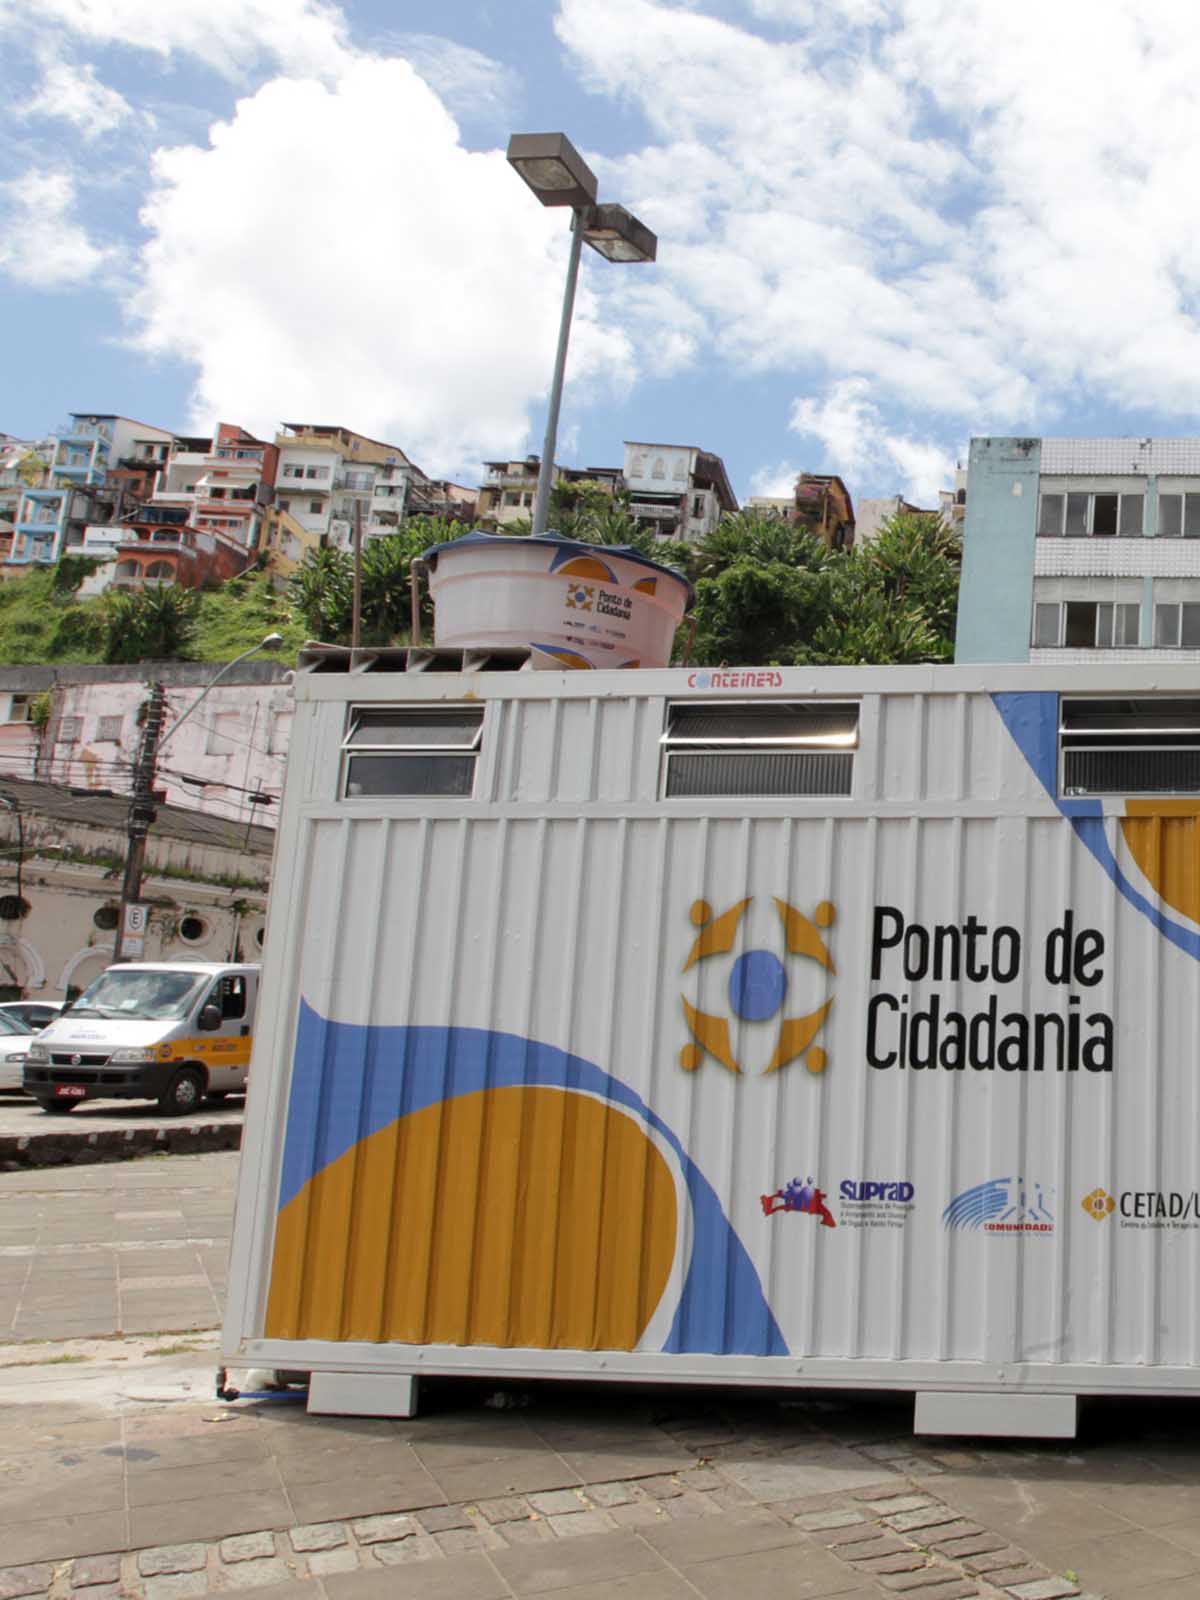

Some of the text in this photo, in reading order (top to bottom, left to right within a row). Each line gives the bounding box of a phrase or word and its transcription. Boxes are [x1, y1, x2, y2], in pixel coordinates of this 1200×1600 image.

[871, 906, 1105, 987] Ponto de
[866, 993, 1113, 1072] Cidadania
